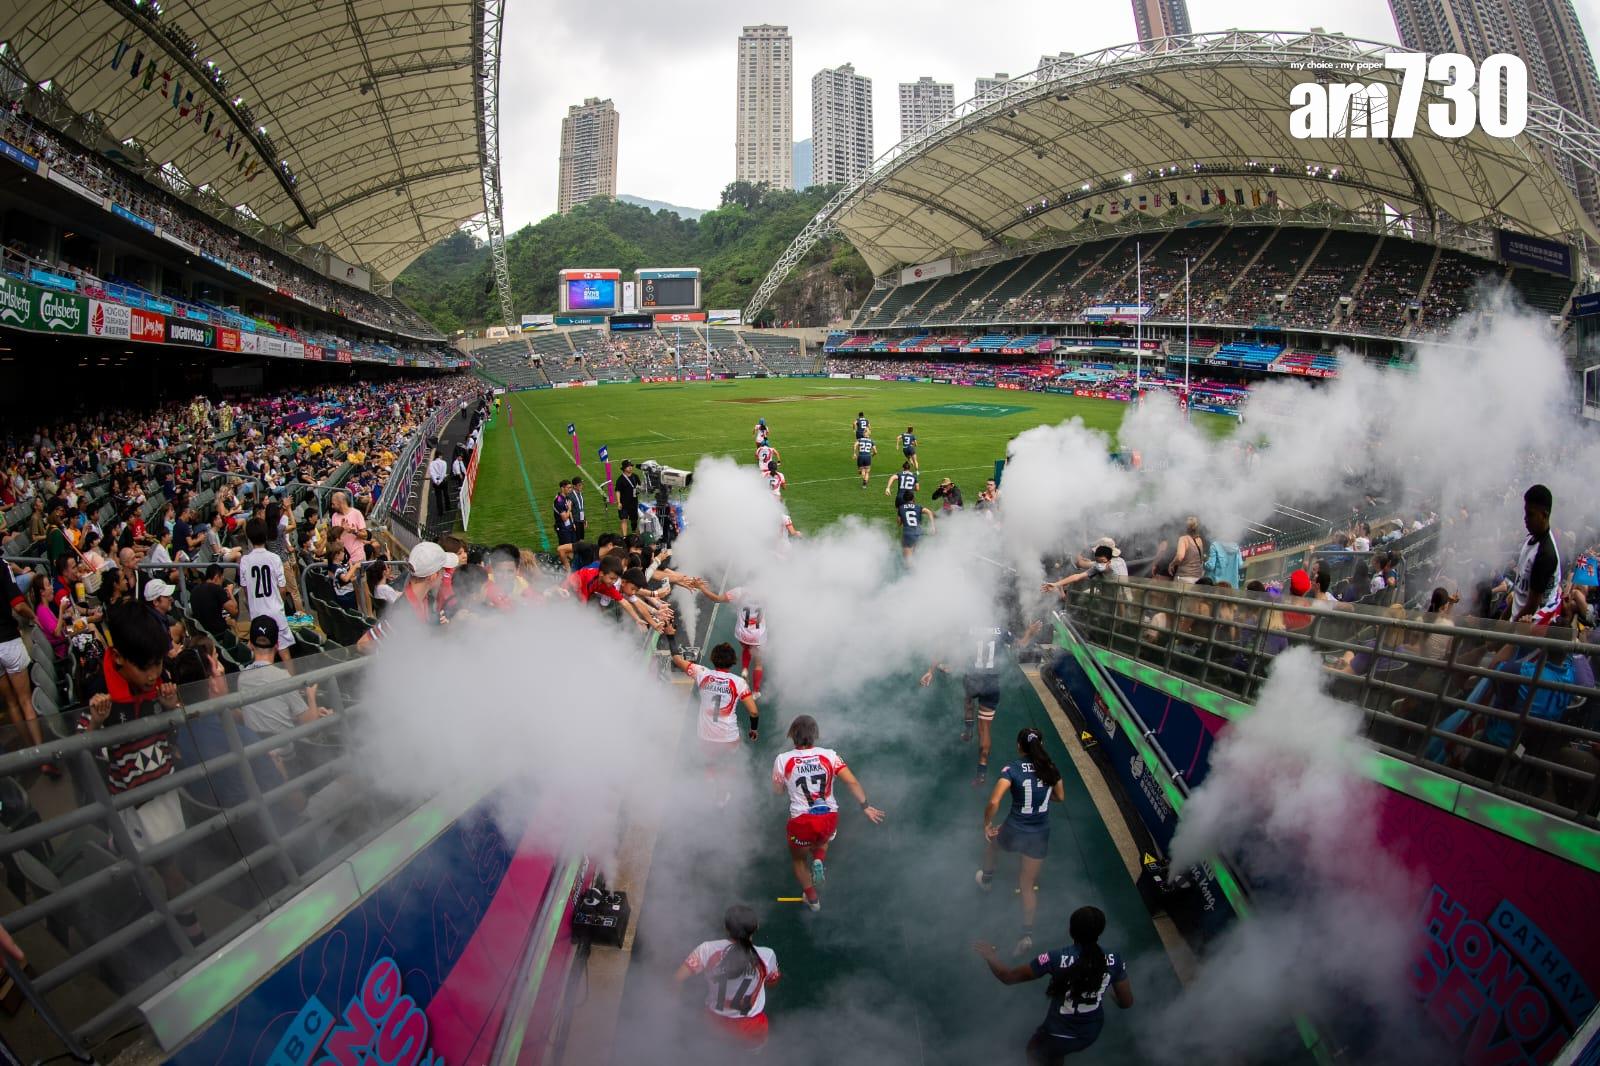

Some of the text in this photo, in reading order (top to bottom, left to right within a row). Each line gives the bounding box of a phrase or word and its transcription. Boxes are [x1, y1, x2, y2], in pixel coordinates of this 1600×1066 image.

[40, 291, 81, 327] Carlsberg
[171, 325, 204, 343] RUGBYPASS
[860, 420, 867, 429] 2
[859, 441, 872, 453] 22
[904, 436, 911, 445] 3
[900, 475, 915, 490] 12
[905, 510, 918, 527] 6
[251, 564, 272, 598] 20
[974, 640, 996, 669] 11
[711, 694, 722, 723] 1
[796, 764, 823, 774] TANAKA
[1021, 762, 1037, 773] SE
[795, 773, 827, 807] 17
[1020, 778, 1053, 815] 17
[1423, 883, 1550, 1041] HONG
[1498, 909, 1586, 1003] CATHAY
[314, 957, 403, 1066] NG
[274, 1010, 322, 1066] BC
